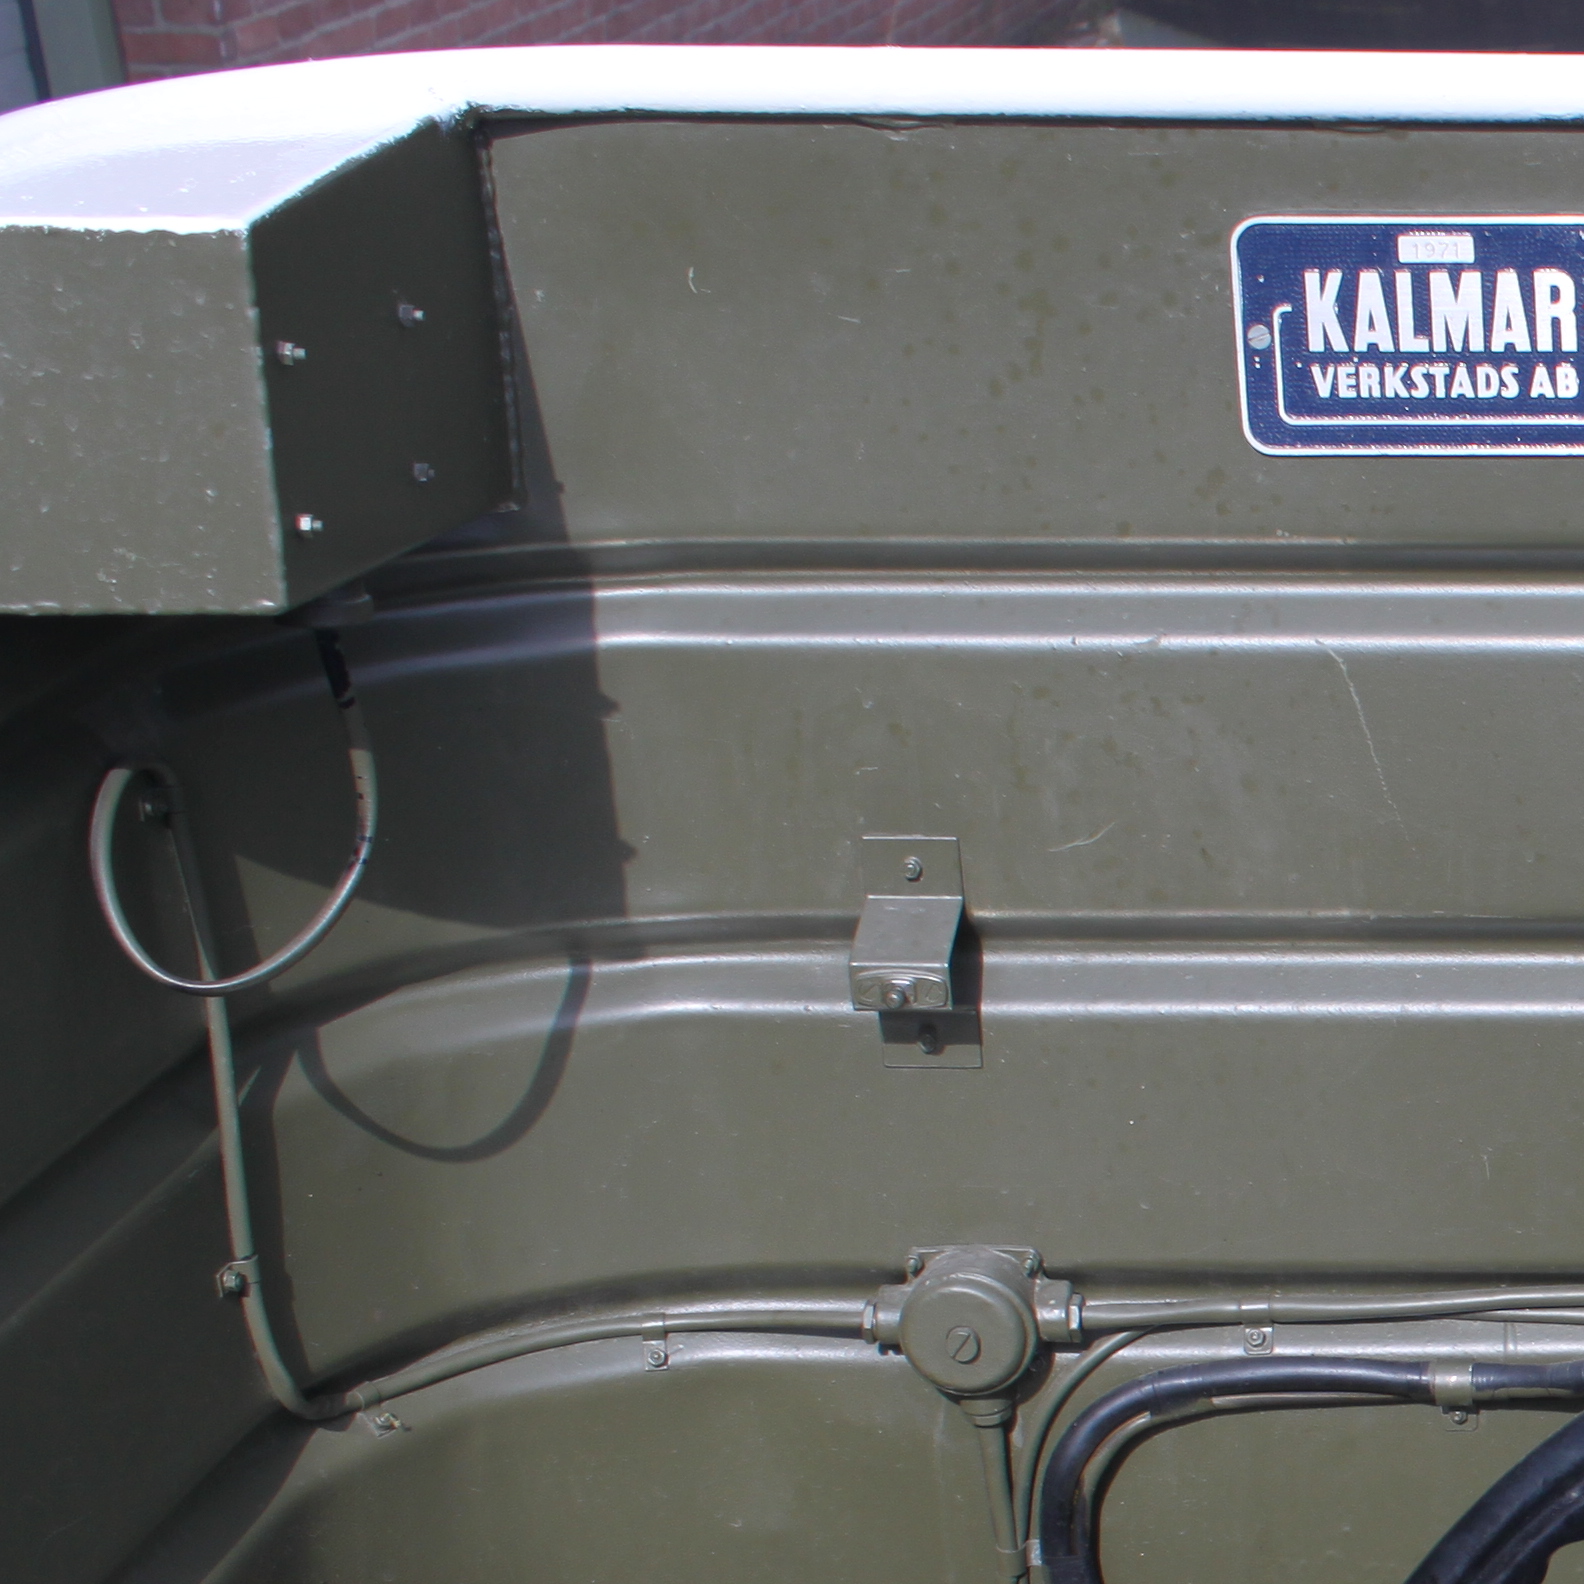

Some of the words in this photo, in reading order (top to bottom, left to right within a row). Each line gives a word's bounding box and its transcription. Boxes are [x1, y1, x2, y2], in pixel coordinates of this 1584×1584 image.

[1410, 242, 1461, 260] 1971
[1304, 269, 1579, 353] KALMAR
[1310, 363, 1520, 399] VERKSTADS
[1529, 363, 1580, 399] AB
